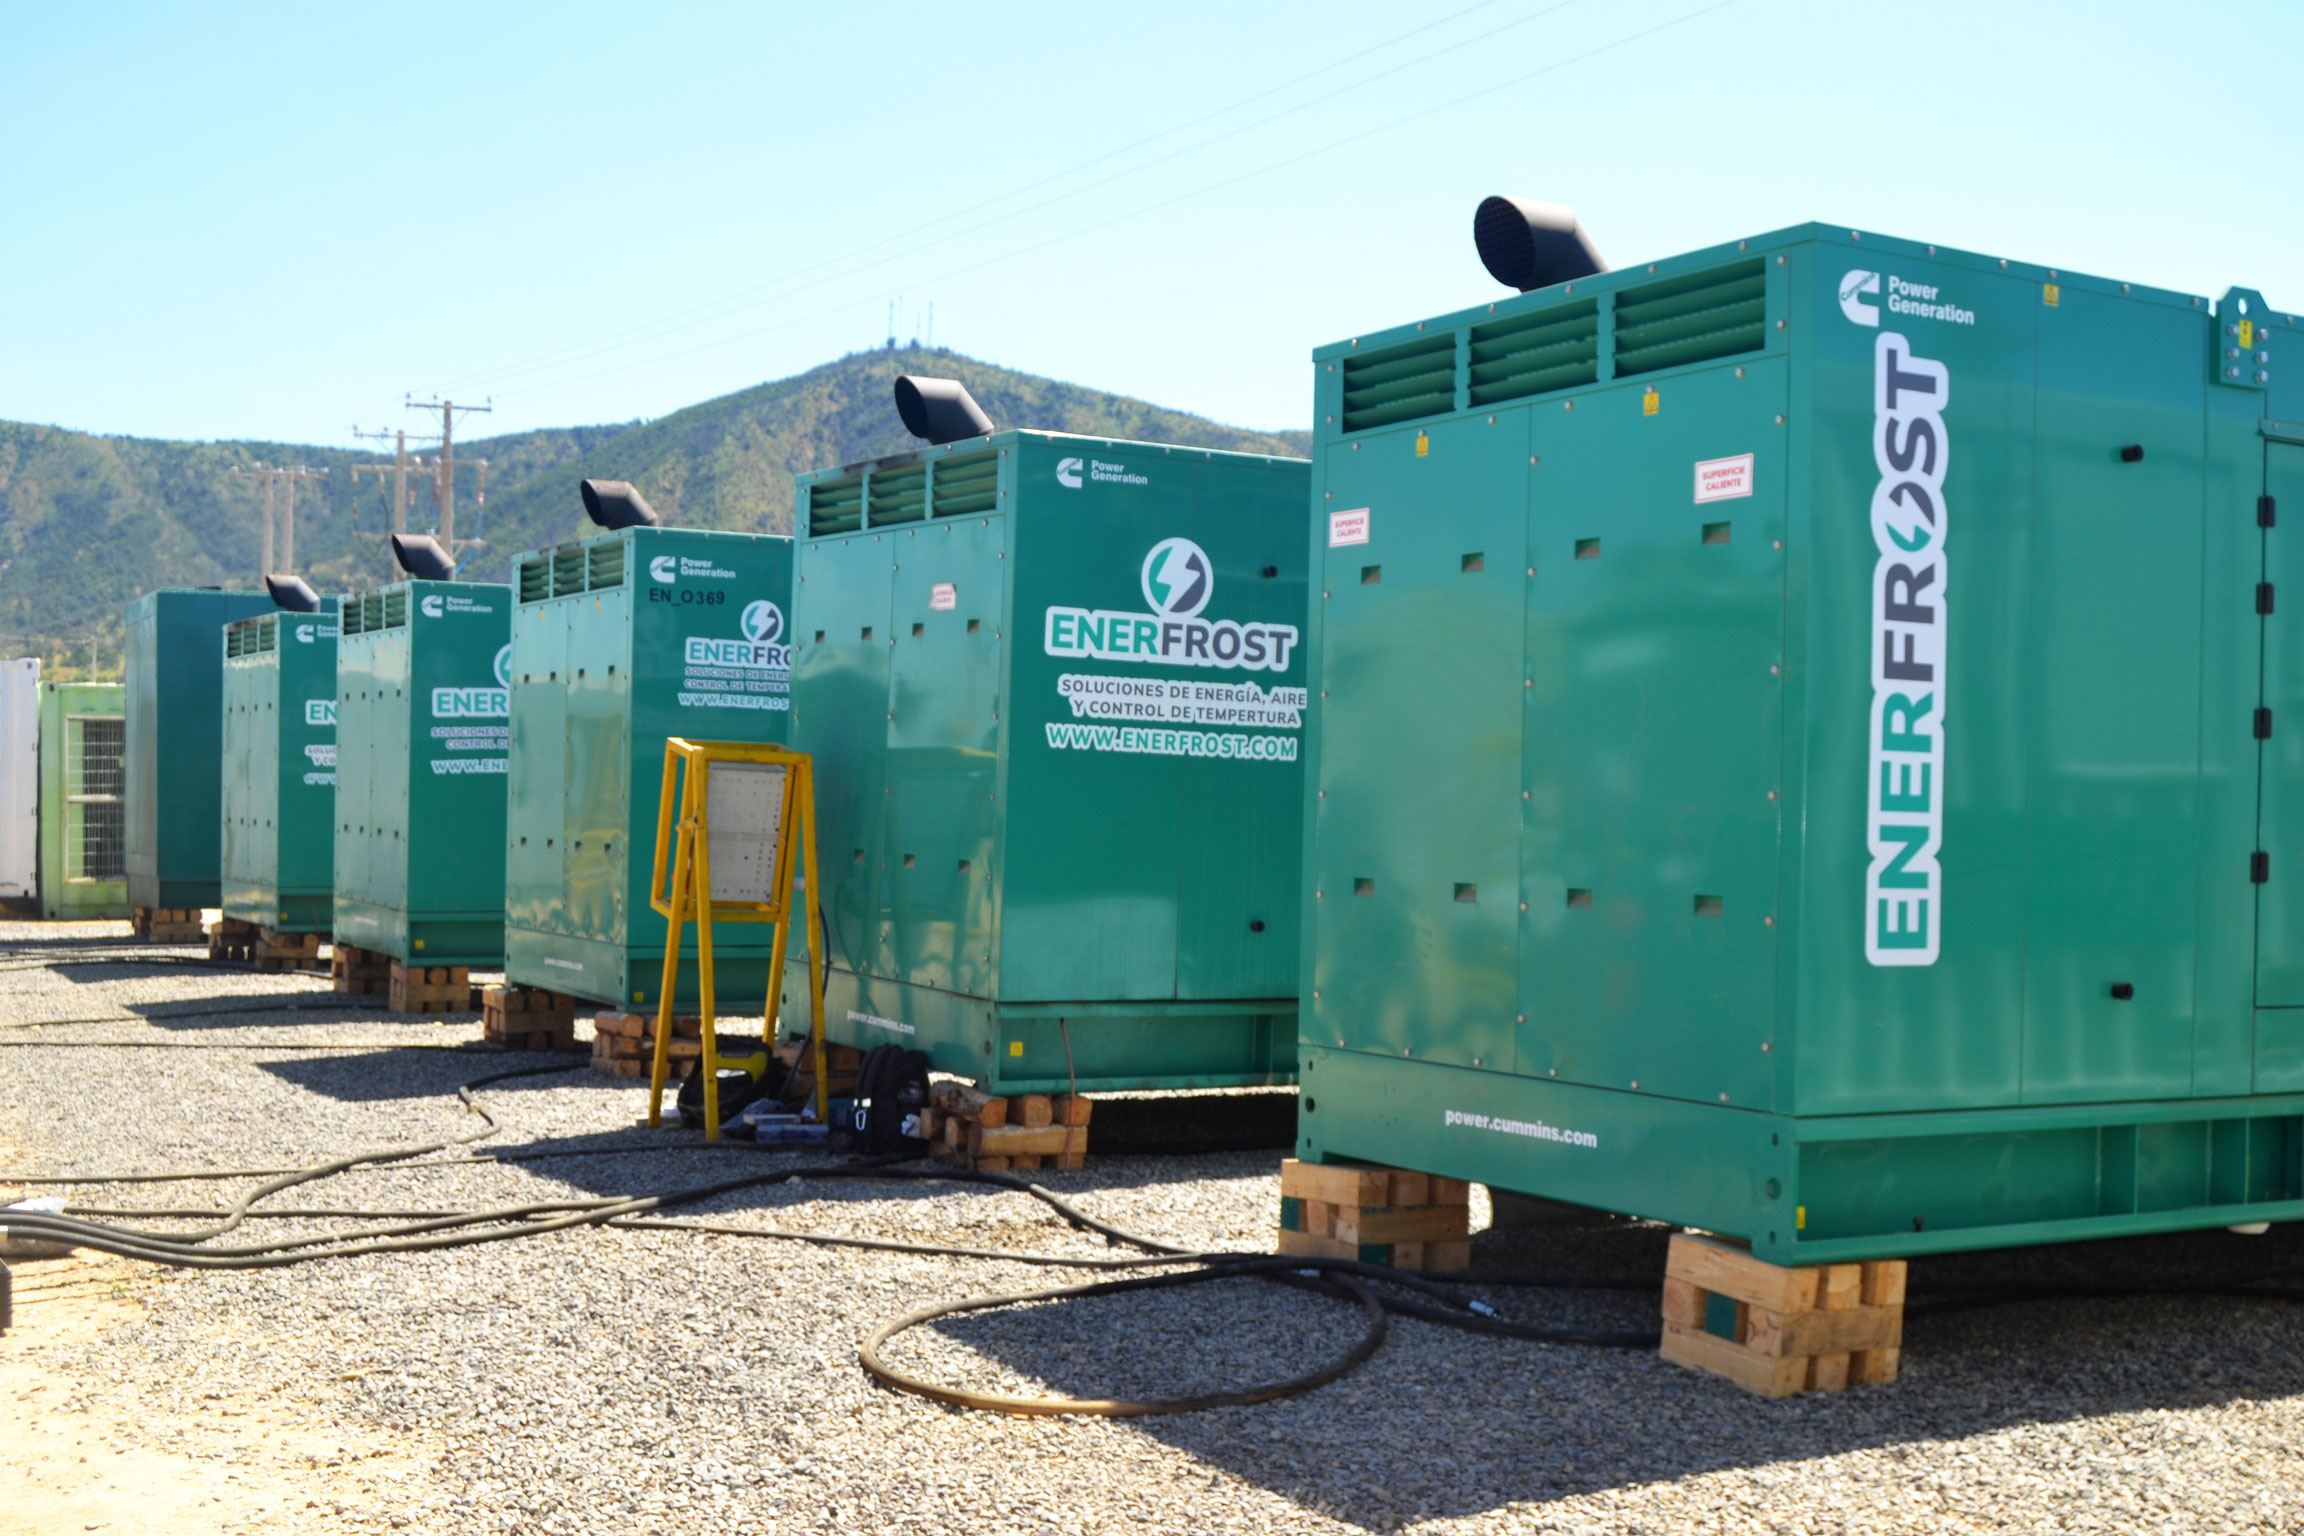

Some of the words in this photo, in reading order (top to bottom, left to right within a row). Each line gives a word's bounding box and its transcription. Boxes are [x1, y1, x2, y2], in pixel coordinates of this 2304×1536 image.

[1888, 275, 1939, 301] Power
[1888, 293, 1975, 325] Generation
[1091, 460, 1124, 473] Power
[1702, 465, 1746, 481] SUPERFICIE
[1091, 469, 1148, 485] Generation
[1705, 478, 1742, 492] CALIENTE
[680, 557, 712, 568] Power
[680, 566, 736, 579] Generation
[1050, 612, 1293, 664] ENERFROST
[686, 667, 744, 679] SOLUCIONES
[747, 671, 758, 679] DE
[685, 680, 728, 689] CONTROL
[732, 682, 743, 690] DE
[1062, 679, 1164, 698] SOLUCIONES
[1170, 685, 1190, 699] DE
[1195, 686, 1266, 706] ENERGÍA,
[1270, 691, 1307, 706] AIRE
[437, 692, 507, 713] ENER
[1074, 700, 1084, 713] Y
[1089, 701, 1165, 717] CONTROL
[1171, 706, 1191, 719] DE
[1196, 707, 1298, 725] TEMPERTURA
[1048, 726, 1296, 758] WWW.ENERFROST.COM
[1445, 1109, 1598, 1149] power.cummins.com
